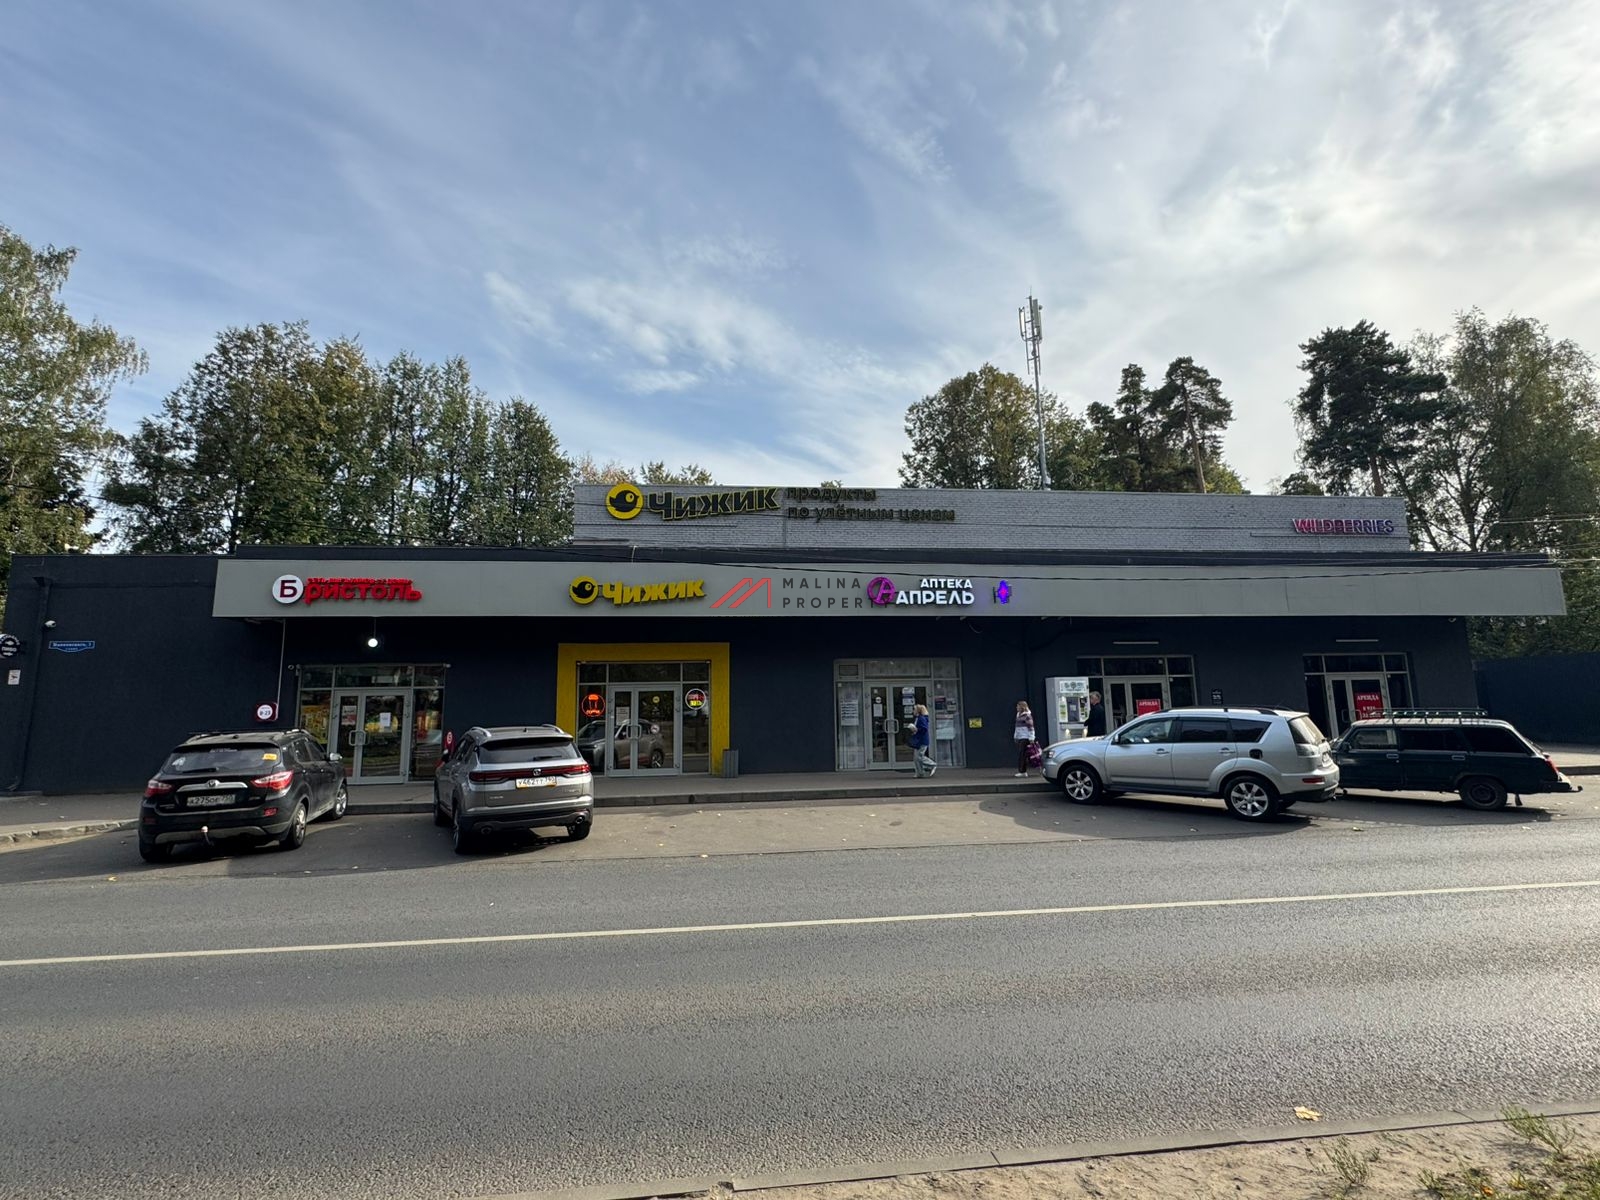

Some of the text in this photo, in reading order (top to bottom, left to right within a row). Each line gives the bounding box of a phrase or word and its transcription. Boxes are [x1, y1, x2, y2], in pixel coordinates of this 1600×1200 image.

[786, 487, 876, 503] продукты
[650, 488, 779, 521] Чижик
[787, 504, 955, 523] по улётным ценам
[1292, 518, 1394, 534] WILDBERRIES
[920, 578, 973, 589] АПТЕКА
[602, 579, 706, 605] Чижик
[896, 590, 975, 605] АПРЕЛЬ
